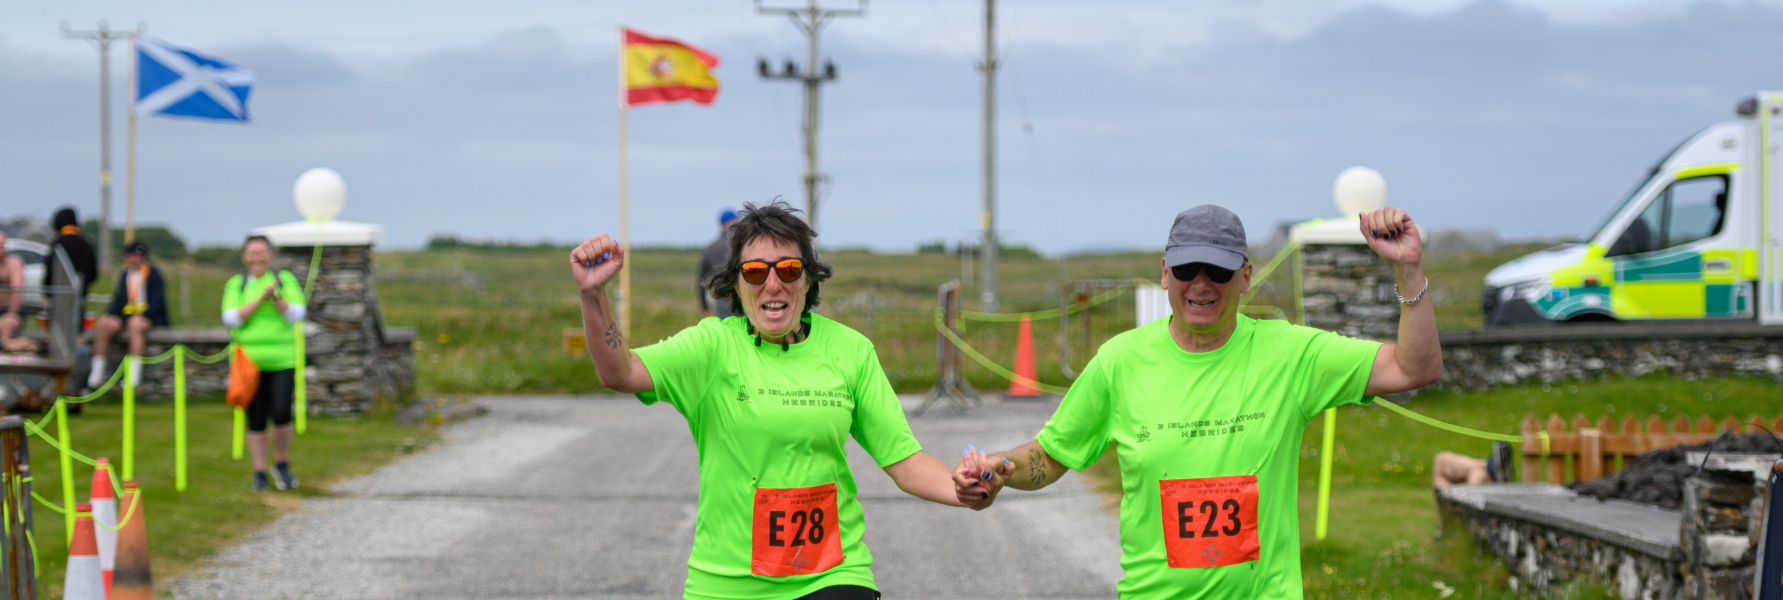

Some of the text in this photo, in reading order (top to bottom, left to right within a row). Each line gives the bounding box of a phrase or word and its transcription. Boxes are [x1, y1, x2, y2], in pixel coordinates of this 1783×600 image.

[768, 388, 811, 397] ISLANDS
[814, 390, 853, 401] MARATHON
[782, 398, 842, 408] HEBRIDES
[1167, 420, 1211, 429] ISLANDS
[1214, 411, 1266, 427] MARATHON
[1181, 424, 1245, 438] HEBRIDES
[1218, 480, 1254, 488] MARATHON
[781, 492, 809, 500] ISLANDS
[809, 489, 836, 498] MARATHON
[1197, 487, 1240, 495] HEBRIDES
[790, 496, 825, 505] HEBRIDES
[1177, 498, 1242, 539] E23
[768, 507, 825, 548] E28
